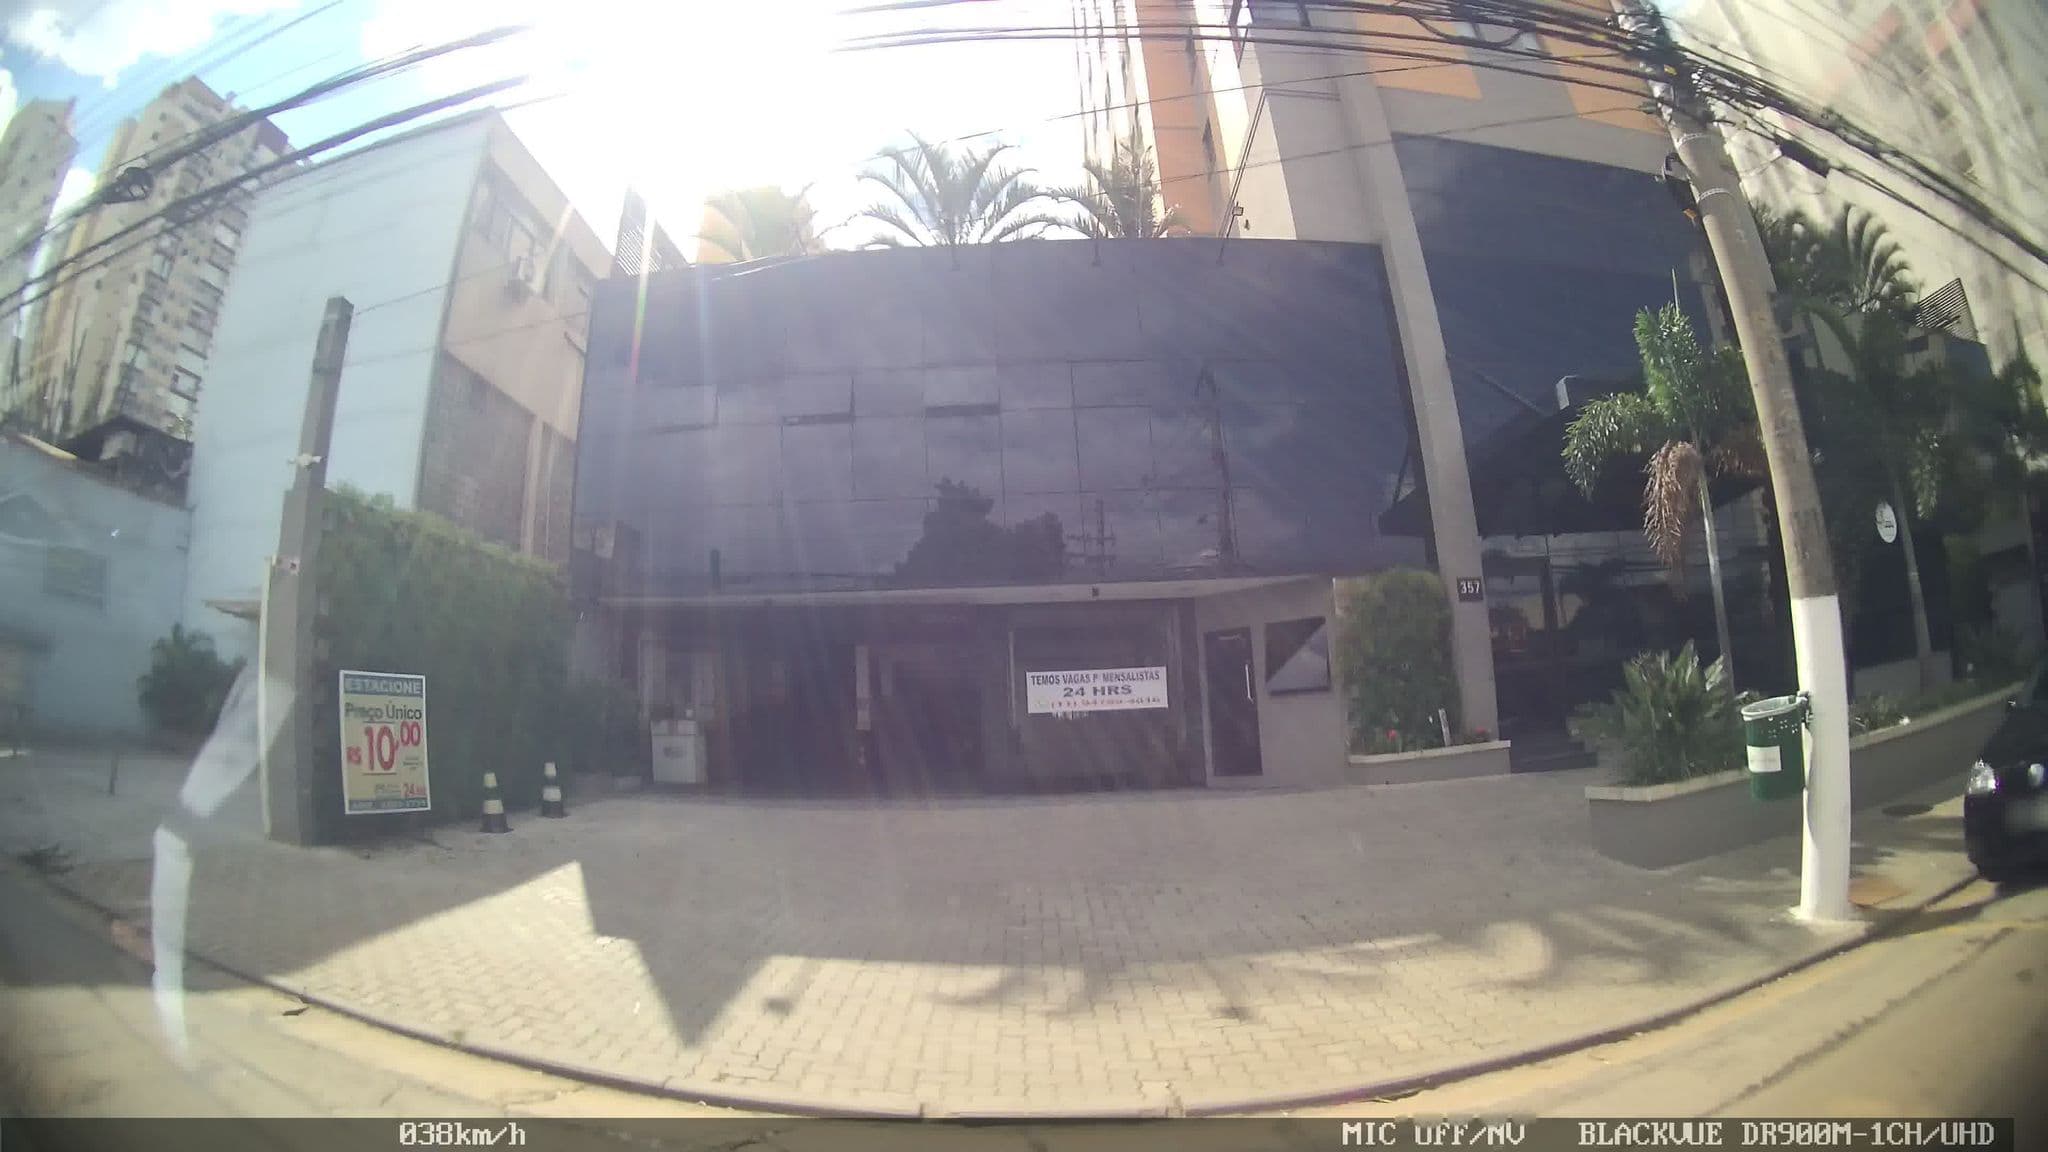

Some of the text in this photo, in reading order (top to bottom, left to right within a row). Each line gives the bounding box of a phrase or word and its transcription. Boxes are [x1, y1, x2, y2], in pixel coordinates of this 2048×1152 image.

[1460, 580, 1480, 594] 357
[344, 677, 422, 695] ESTACIONE
[1030, 675, 1060, 686] TEMOS
[1062, 673, 1091, 685] VAGAS
[1102, 670, 1160, 683] MENSALISTAS
[1063, 685, 1132, 697] 24 HRS
[345, 700, 422, 721] Preço Único
